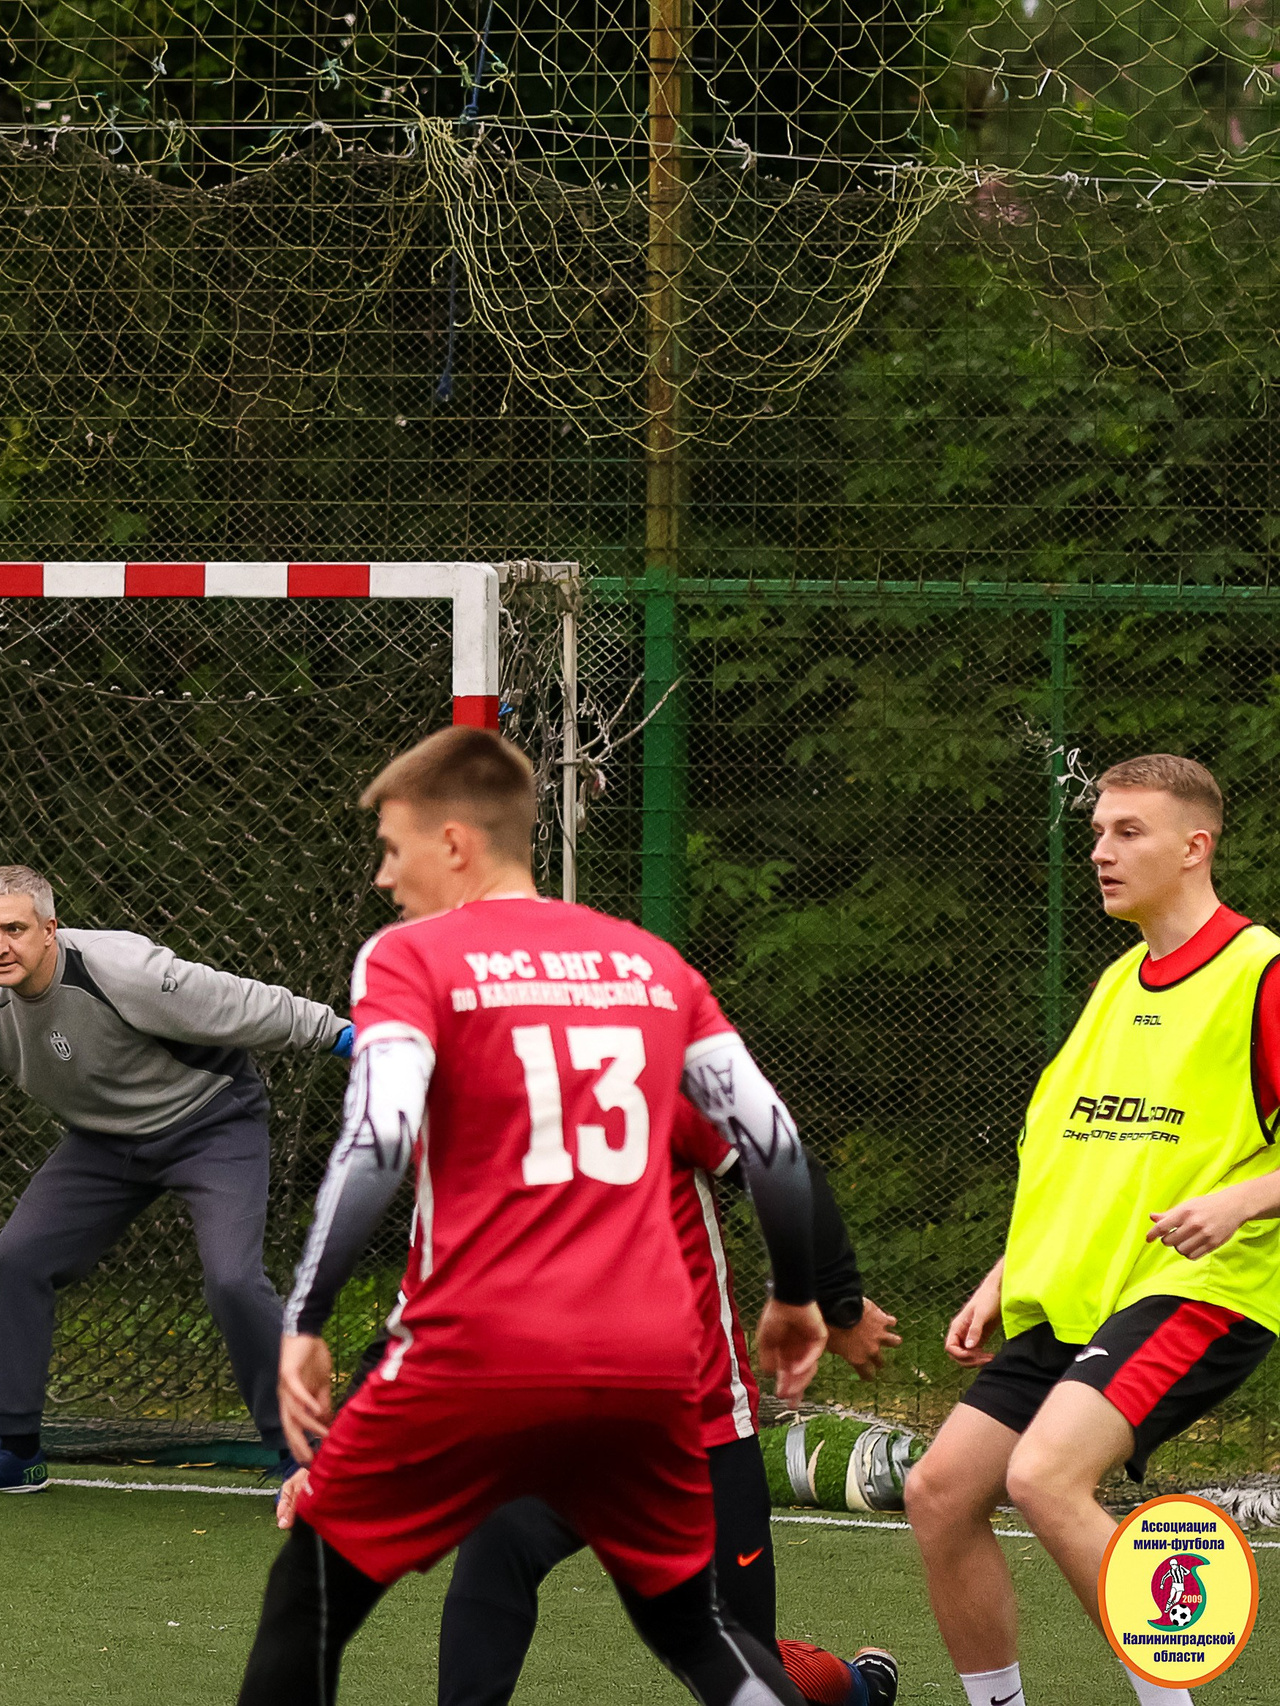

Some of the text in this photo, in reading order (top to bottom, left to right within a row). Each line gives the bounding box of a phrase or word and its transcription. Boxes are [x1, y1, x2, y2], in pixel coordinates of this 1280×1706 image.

[465, 949, 654, 982] УФС ВНГ РФ
[511, 1023, 650, 1186] 13
